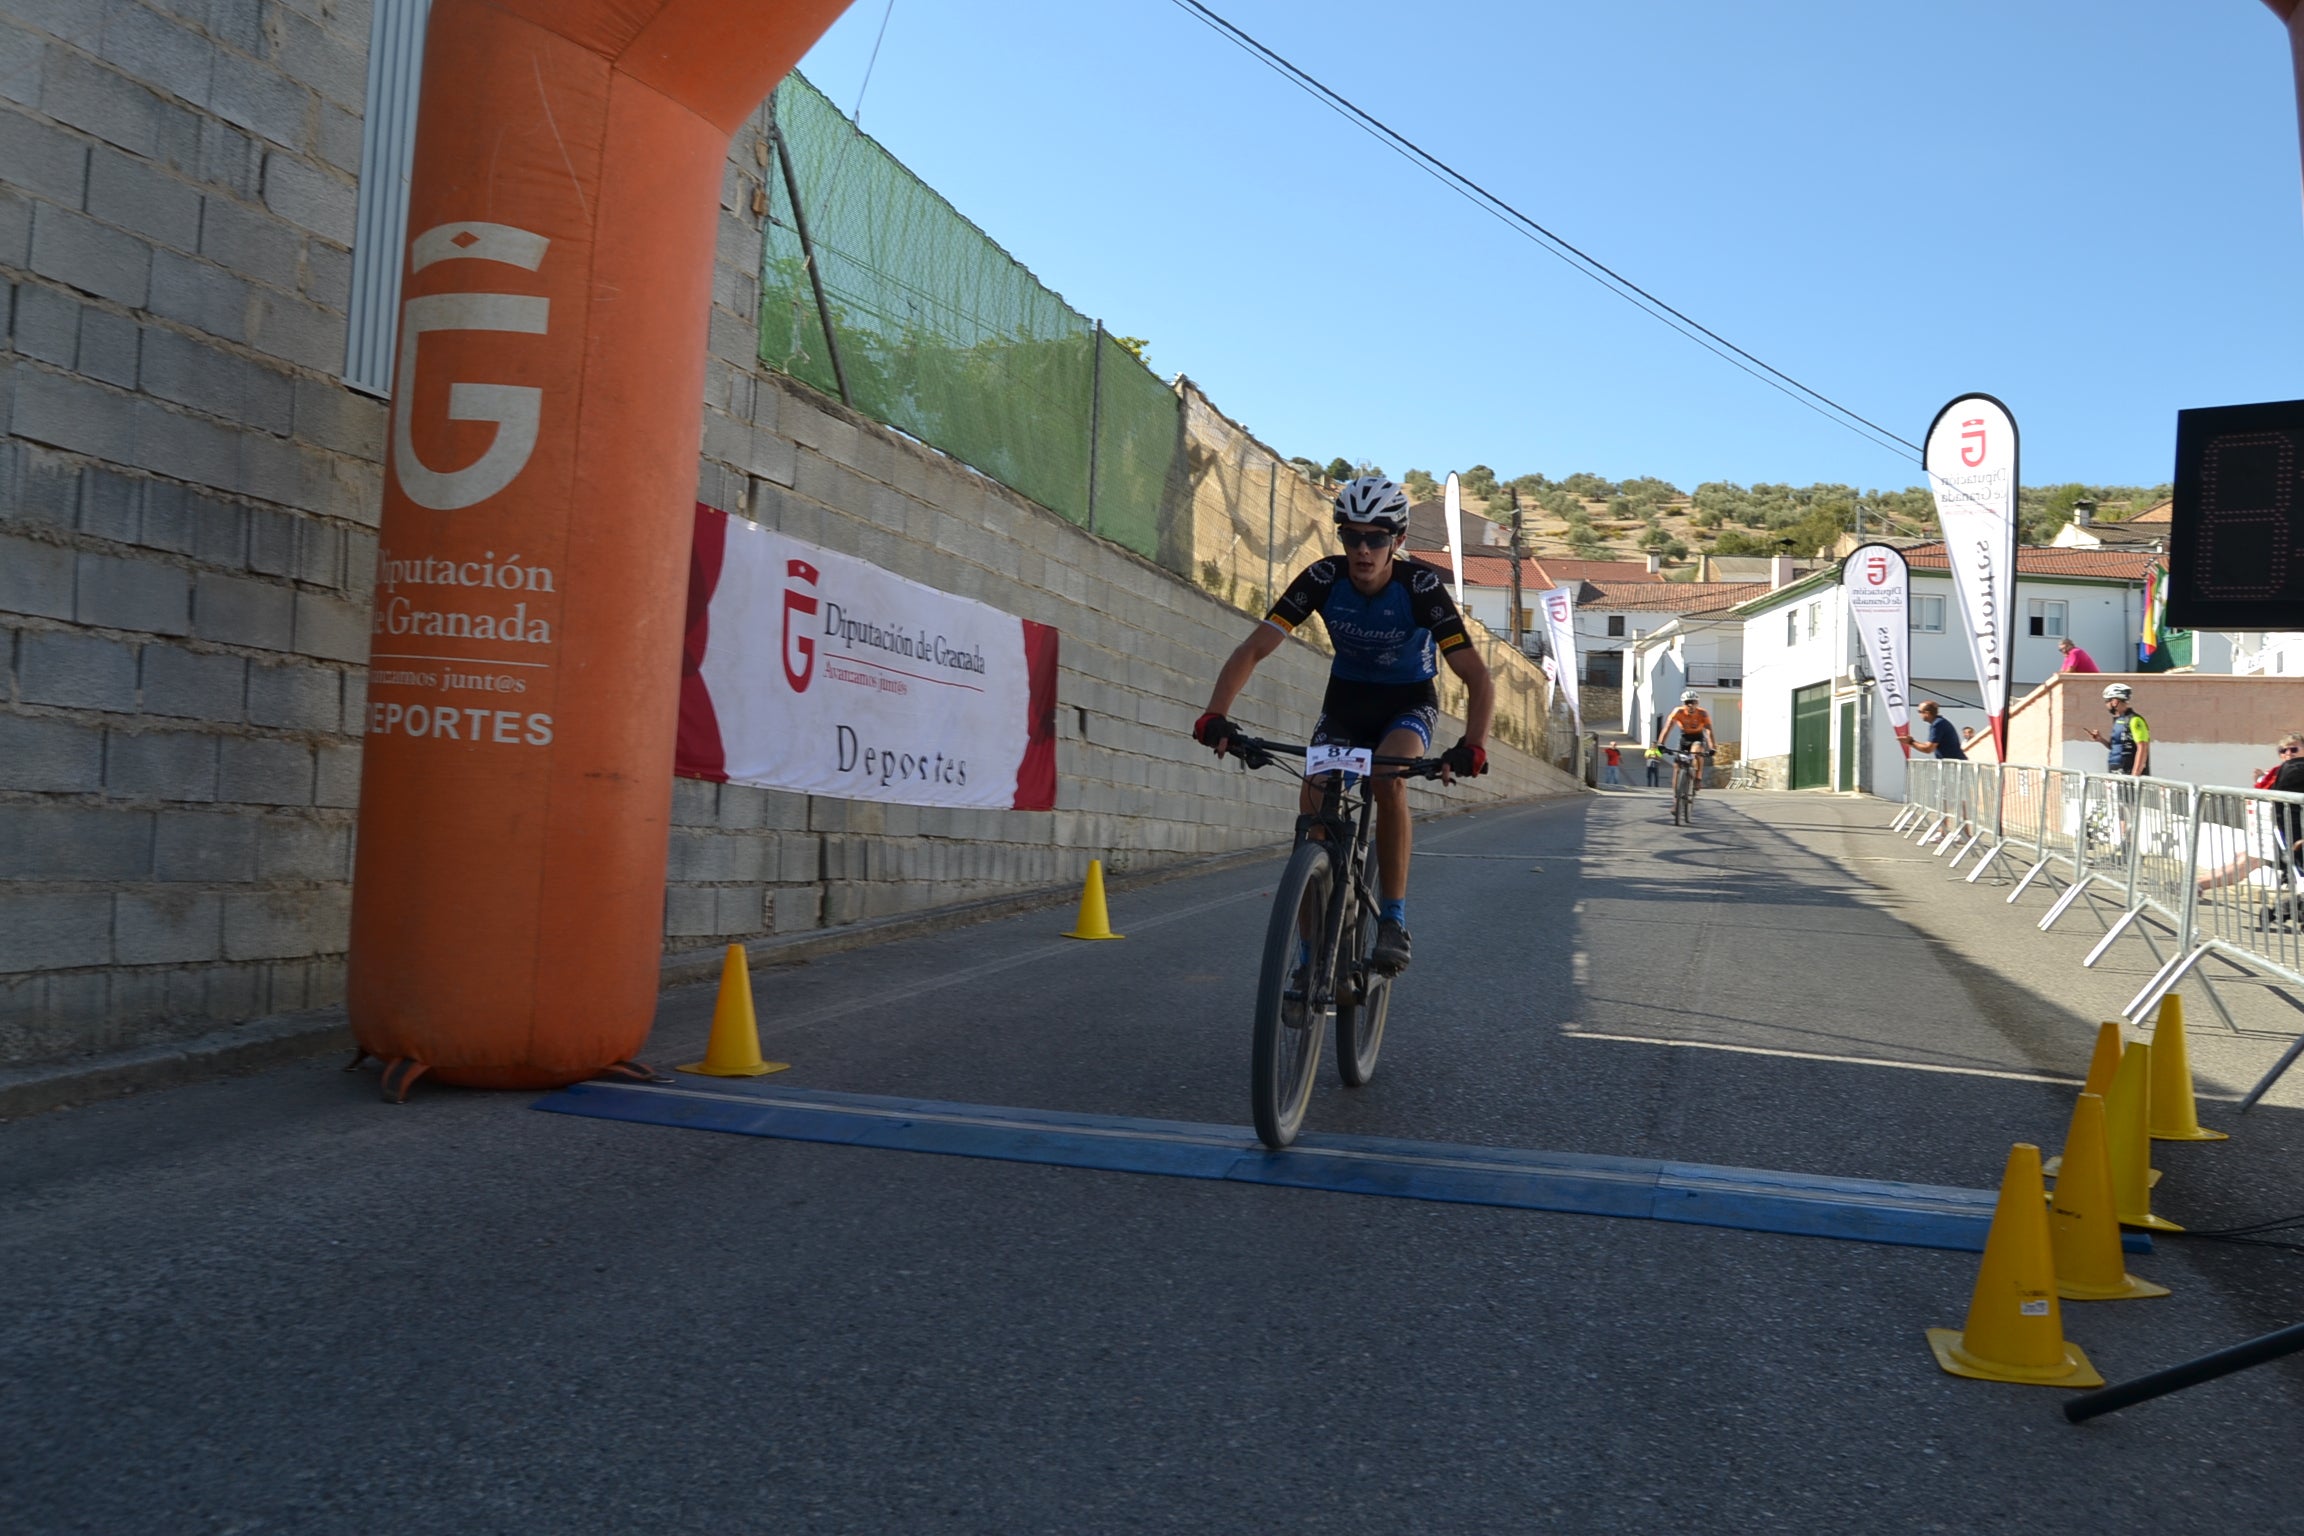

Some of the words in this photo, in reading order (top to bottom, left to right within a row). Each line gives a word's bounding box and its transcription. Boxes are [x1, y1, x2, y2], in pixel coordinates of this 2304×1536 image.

[386, 596, 552, 643] Granada
[824, 602, 914, 657] Diputación
[916, 630, 933, 661] de
[933, 635, 985, 675] Granada
[440, 667, 526, 693] junt@s
[823, 661, 877, 687] Avanzamos
[835, 725, 967, 787] Deportes
